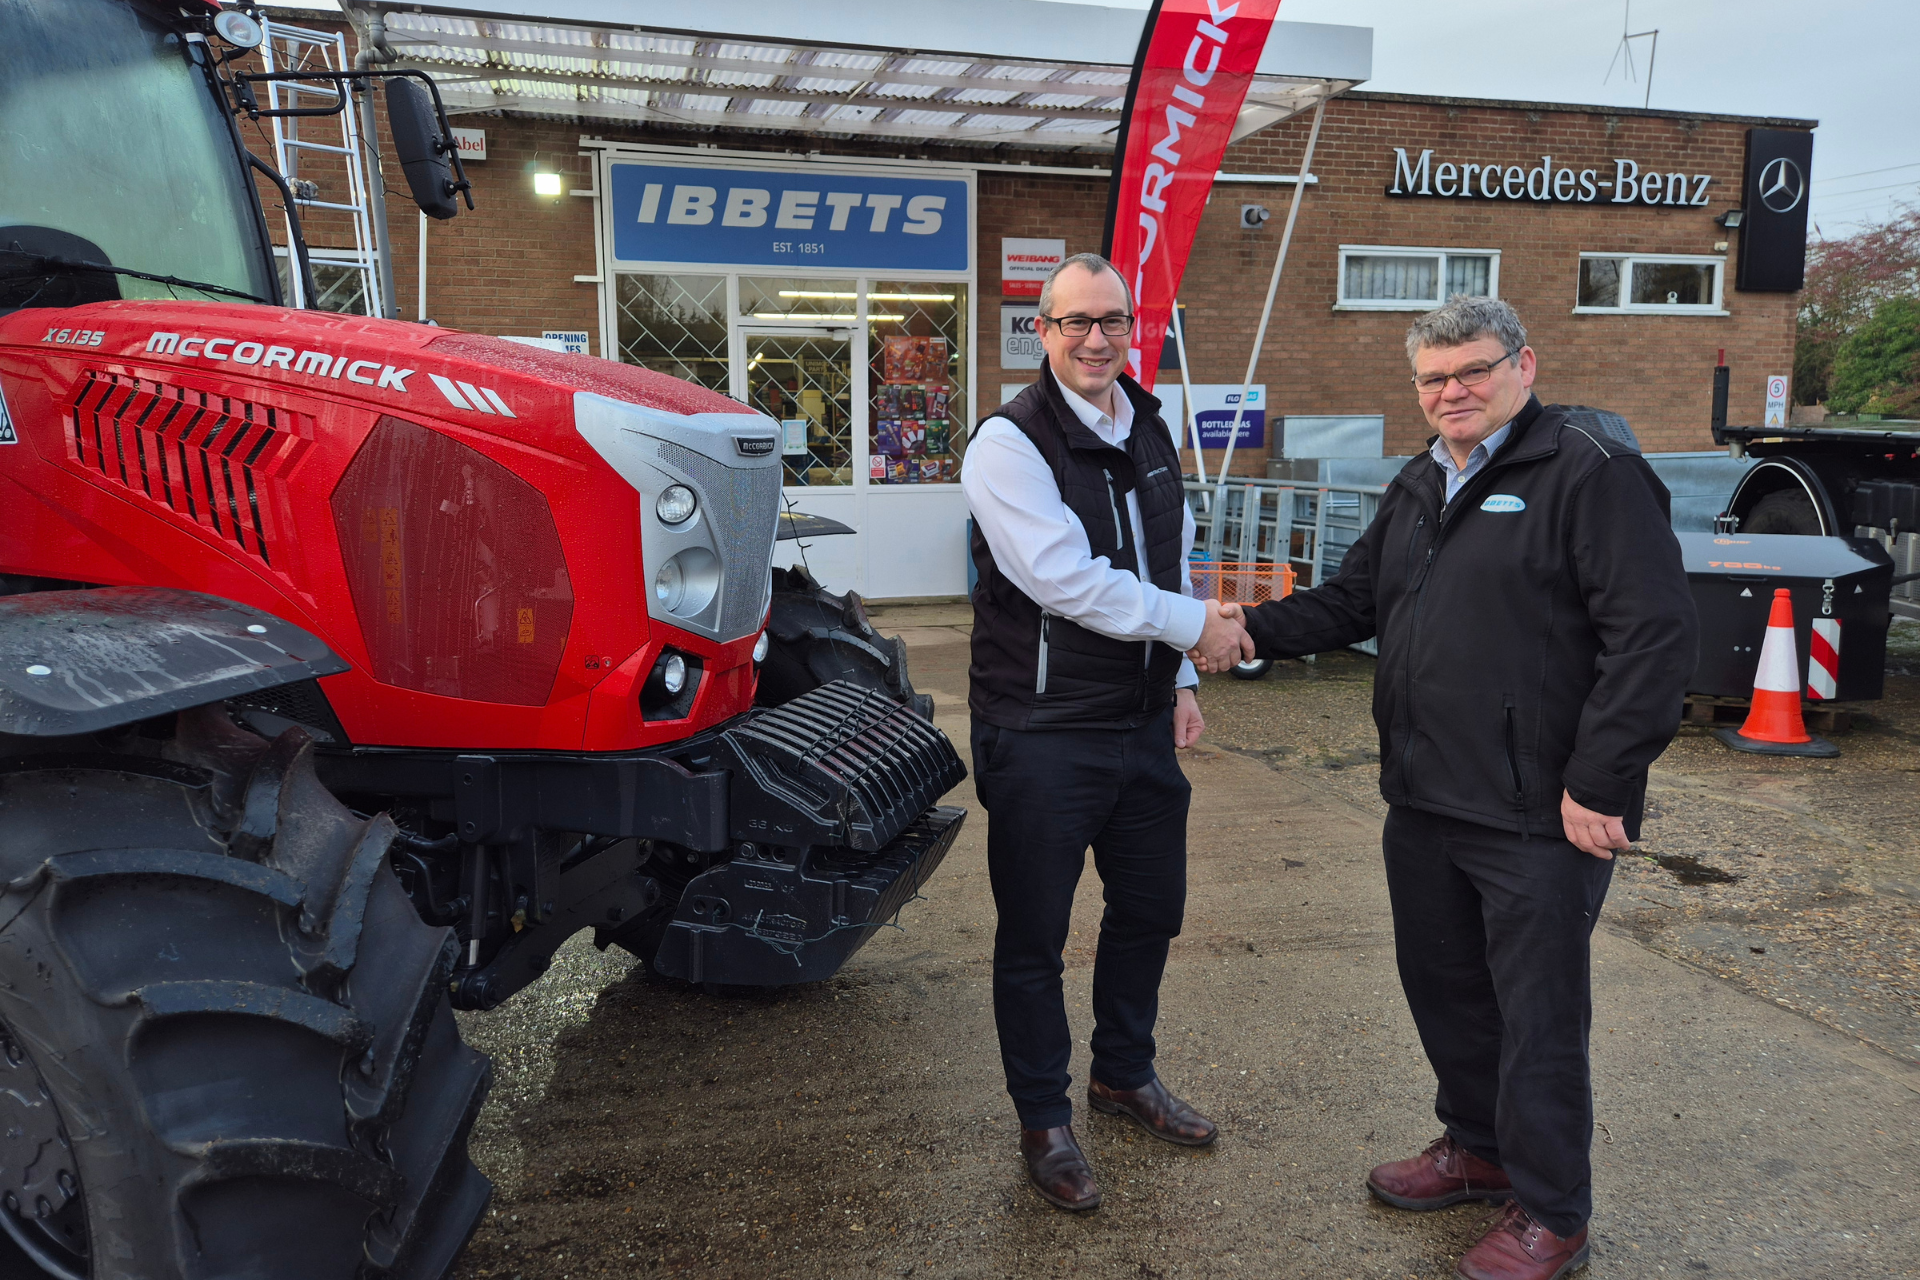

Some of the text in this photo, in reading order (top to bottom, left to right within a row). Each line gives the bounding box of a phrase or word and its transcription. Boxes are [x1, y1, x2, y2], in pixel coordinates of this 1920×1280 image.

[1389, 147, 1712, 207] Mercedes-Benz
[637, 183, 947, 235] IBBETTS
[773, 242, 825, 254] EST. 1851
[1007, 254, 1060, 263] WEIBANG
[42, 328, 106, 346] X6.135
[146, 331, 415, 392] McCORMICK
[1774, 383, 1780, 393] 5
[1201, 421, 1234, 429] BOTTLED
